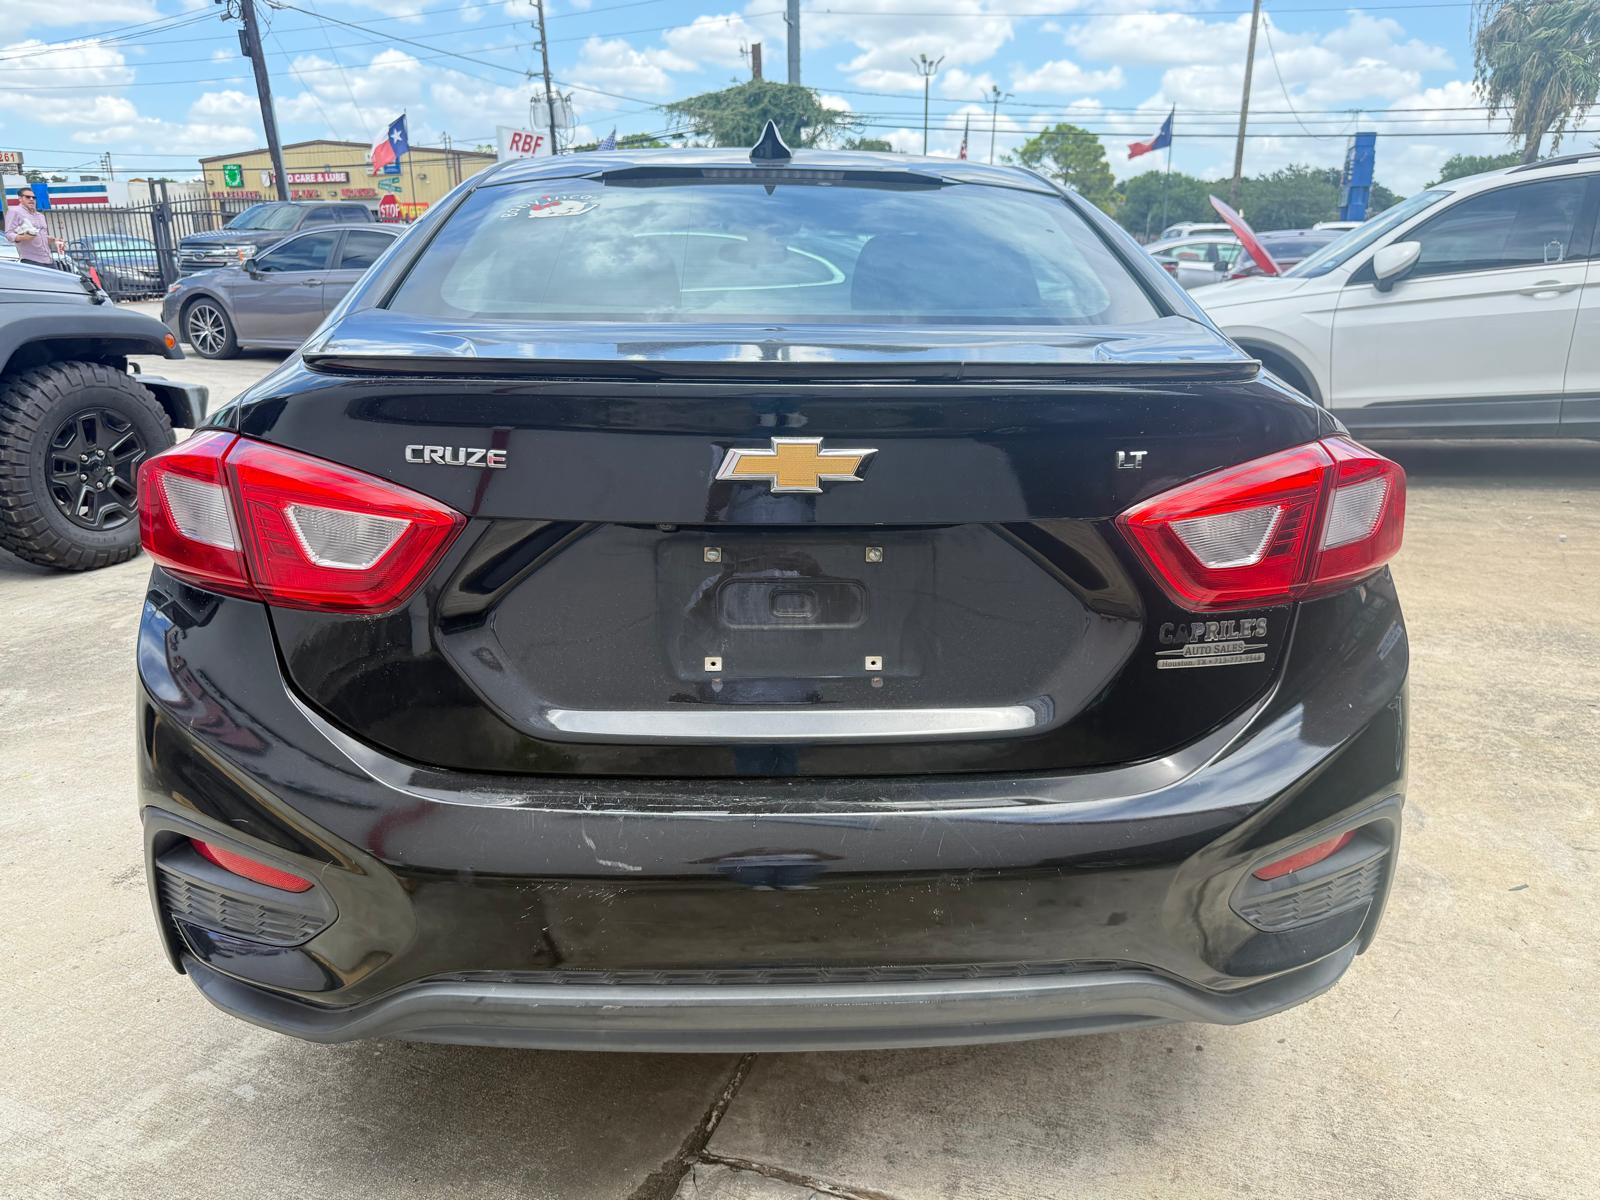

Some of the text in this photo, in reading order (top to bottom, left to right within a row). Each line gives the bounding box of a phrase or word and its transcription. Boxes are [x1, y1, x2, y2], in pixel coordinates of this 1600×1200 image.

[509, 132, 544, 154] RBF
[294, 173, 317, 183] CARE
[317, 173, 324, 182] &
[325, 172, 347, 182] LUBE
[380, 203, 401, 218] STOP
[405, 444, 507, 469] CRUZE
[1115, 450, 1149, 469] LT
[1159, 617, 1268, 644] CAPRILE'S
[1184, 643, 1244, 656] AUTO SALES
